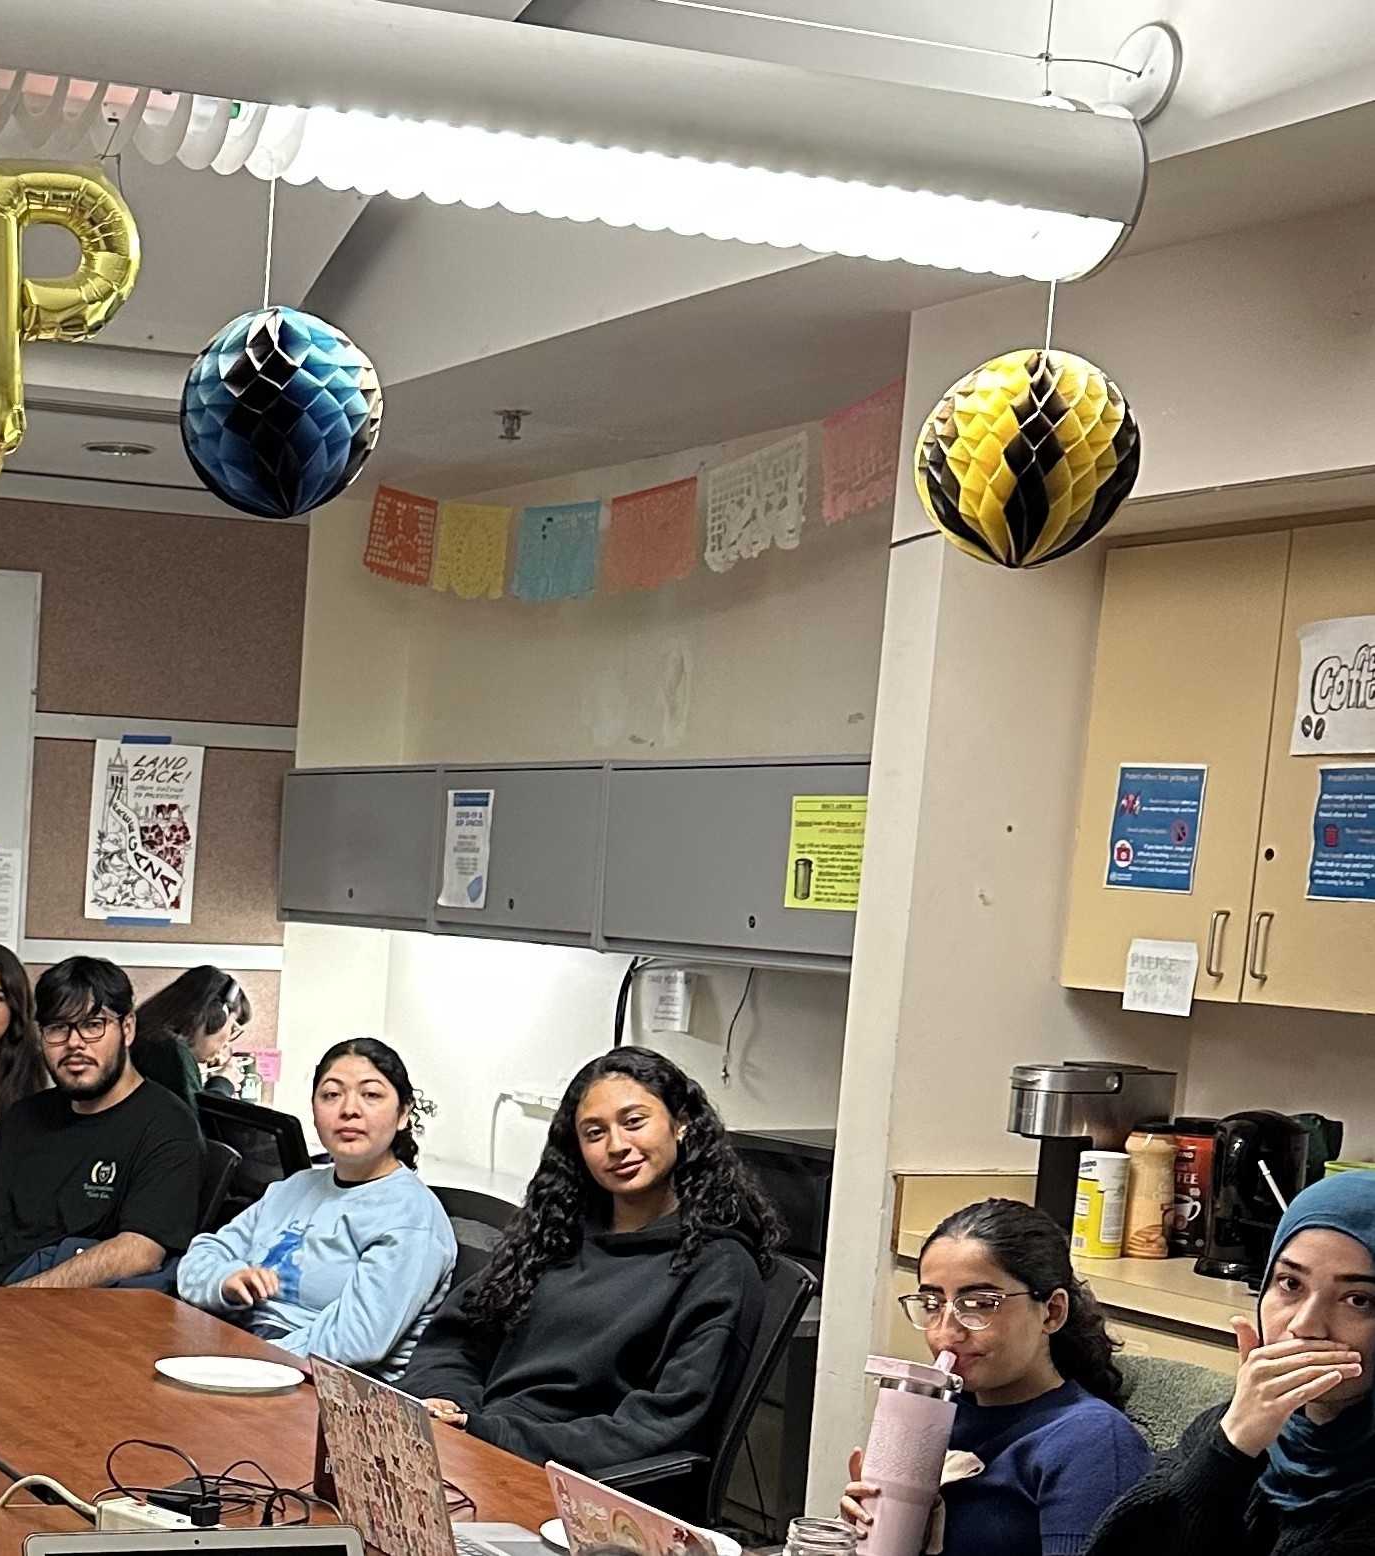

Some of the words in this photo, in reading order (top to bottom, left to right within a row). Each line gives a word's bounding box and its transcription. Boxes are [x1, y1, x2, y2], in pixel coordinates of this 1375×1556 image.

[133, 755, 188, 770] LAND
[130, 768, 193, 784] BACK!
[1131, 953, 1177, 973] PLEASE
